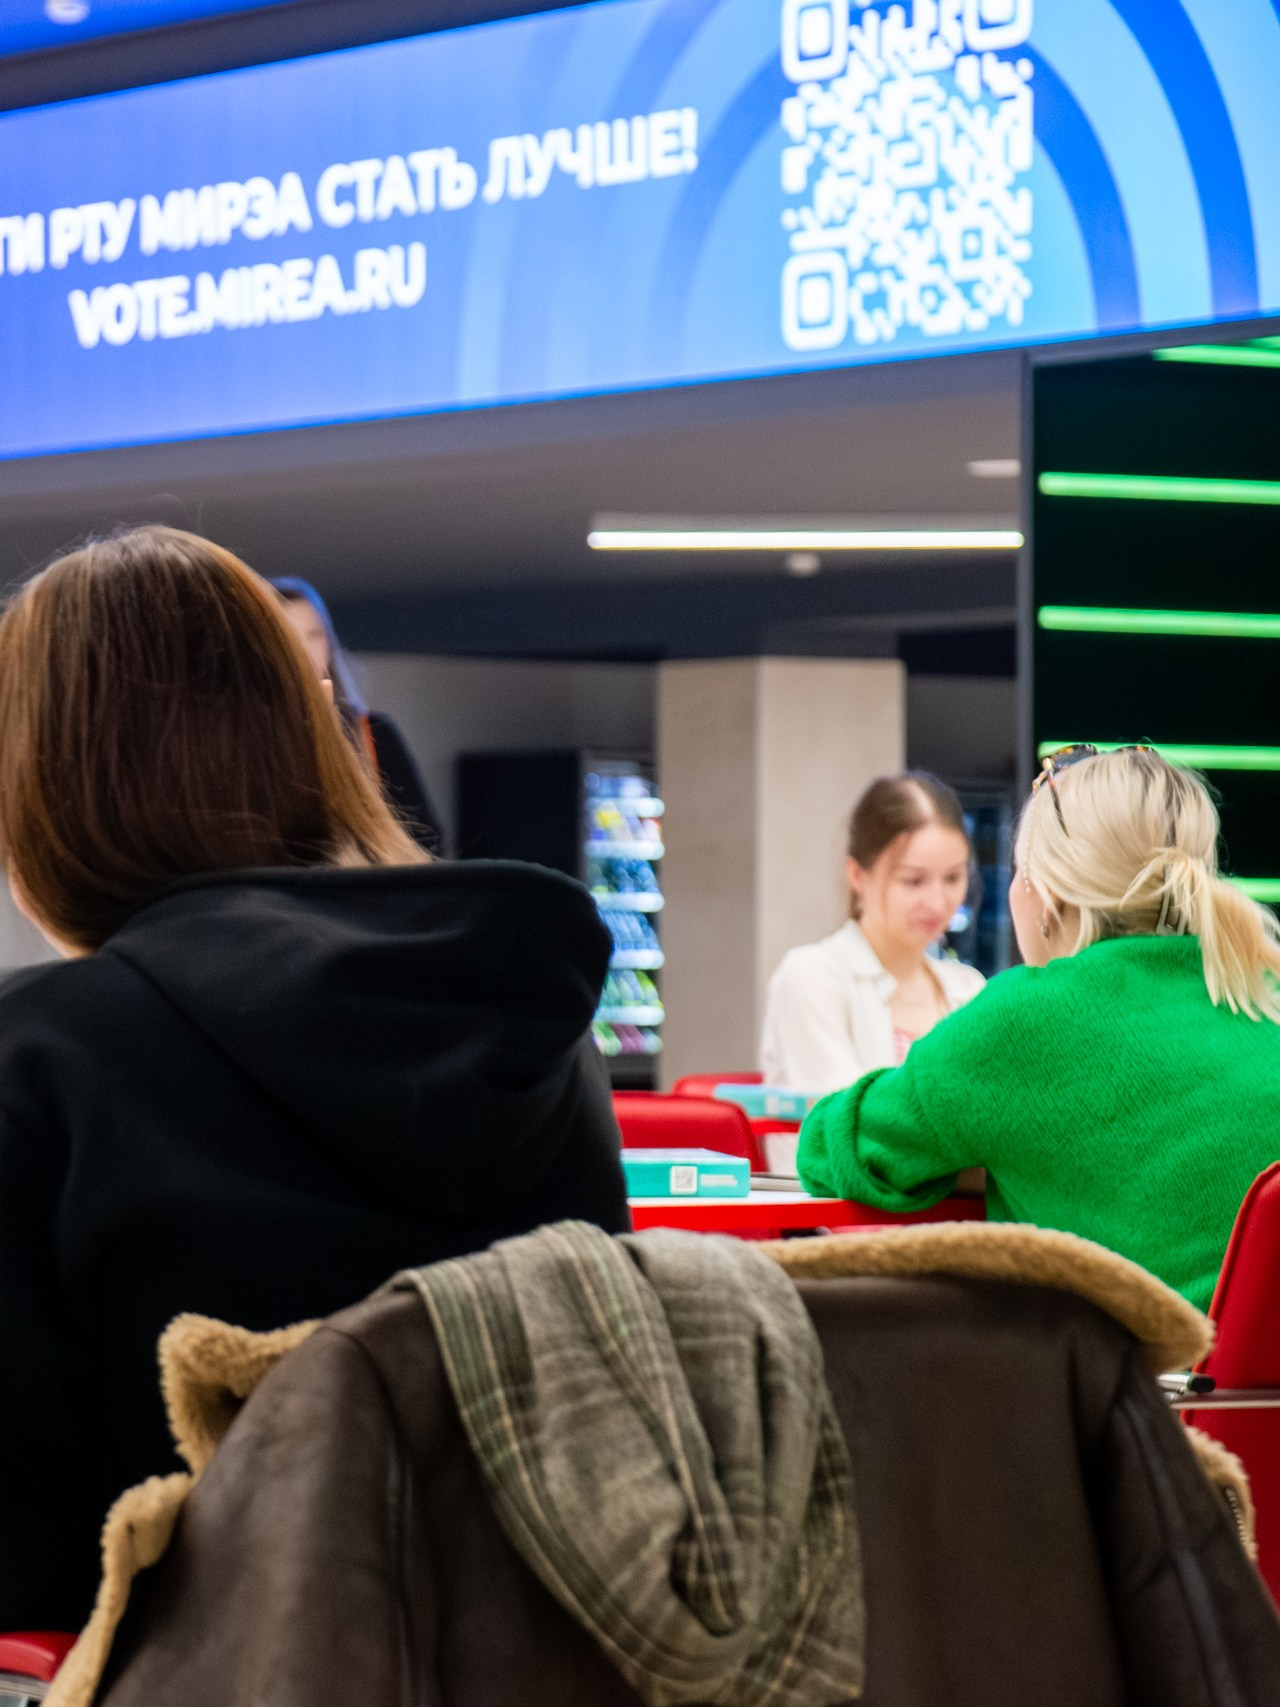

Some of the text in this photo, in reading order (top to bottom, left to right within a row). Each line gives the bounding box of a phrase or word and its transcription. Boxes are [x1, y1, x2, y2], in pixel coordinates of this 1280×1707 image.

[49, 198, 136, 269] РТУ
[139, 172, 312, 256] МИРЭА
[316, 147, 477, 229] СТАТЬ
[482, 107, 698, 205] ЛУЧШЕ!
[69, 241, 426, 349] VOTE.MIREA.RU
